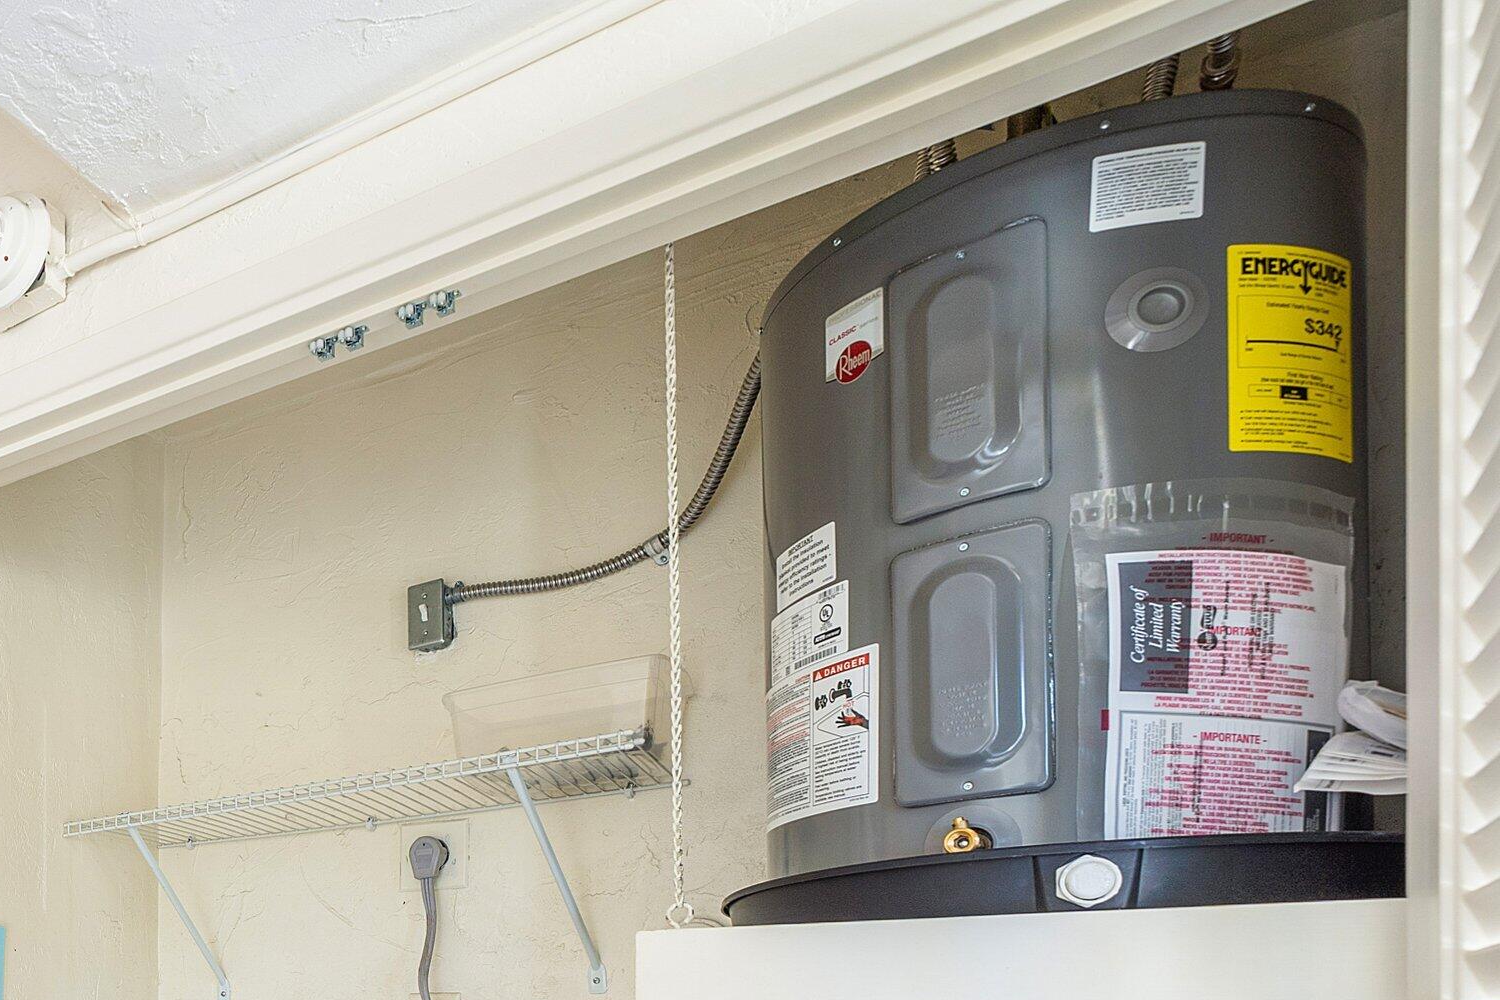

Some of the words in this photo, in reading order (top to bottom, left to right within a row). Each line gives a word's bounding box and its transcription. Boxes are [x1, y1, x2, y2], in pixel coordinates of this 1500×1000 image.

[1241, 256, 1348, 288] ENERGYGUIDE
[828, 325, 857, 346] CLASSIC
[1304, 318, 1342, 341] $342
[839, 345, 871, 380] Rheem
[1210, 532, 1267, 544] IMPORTANT
[1129, 585, 1149, 601] of
[1130, 602, 1149, 663] Certificate
[1149, 602, 1164, 649] Limited
[1166, 599, 1186, 653] Warranty
[824, 656, 866, 677] DANGER
[1200, 731, 1261, 745] IMPORTANTE
